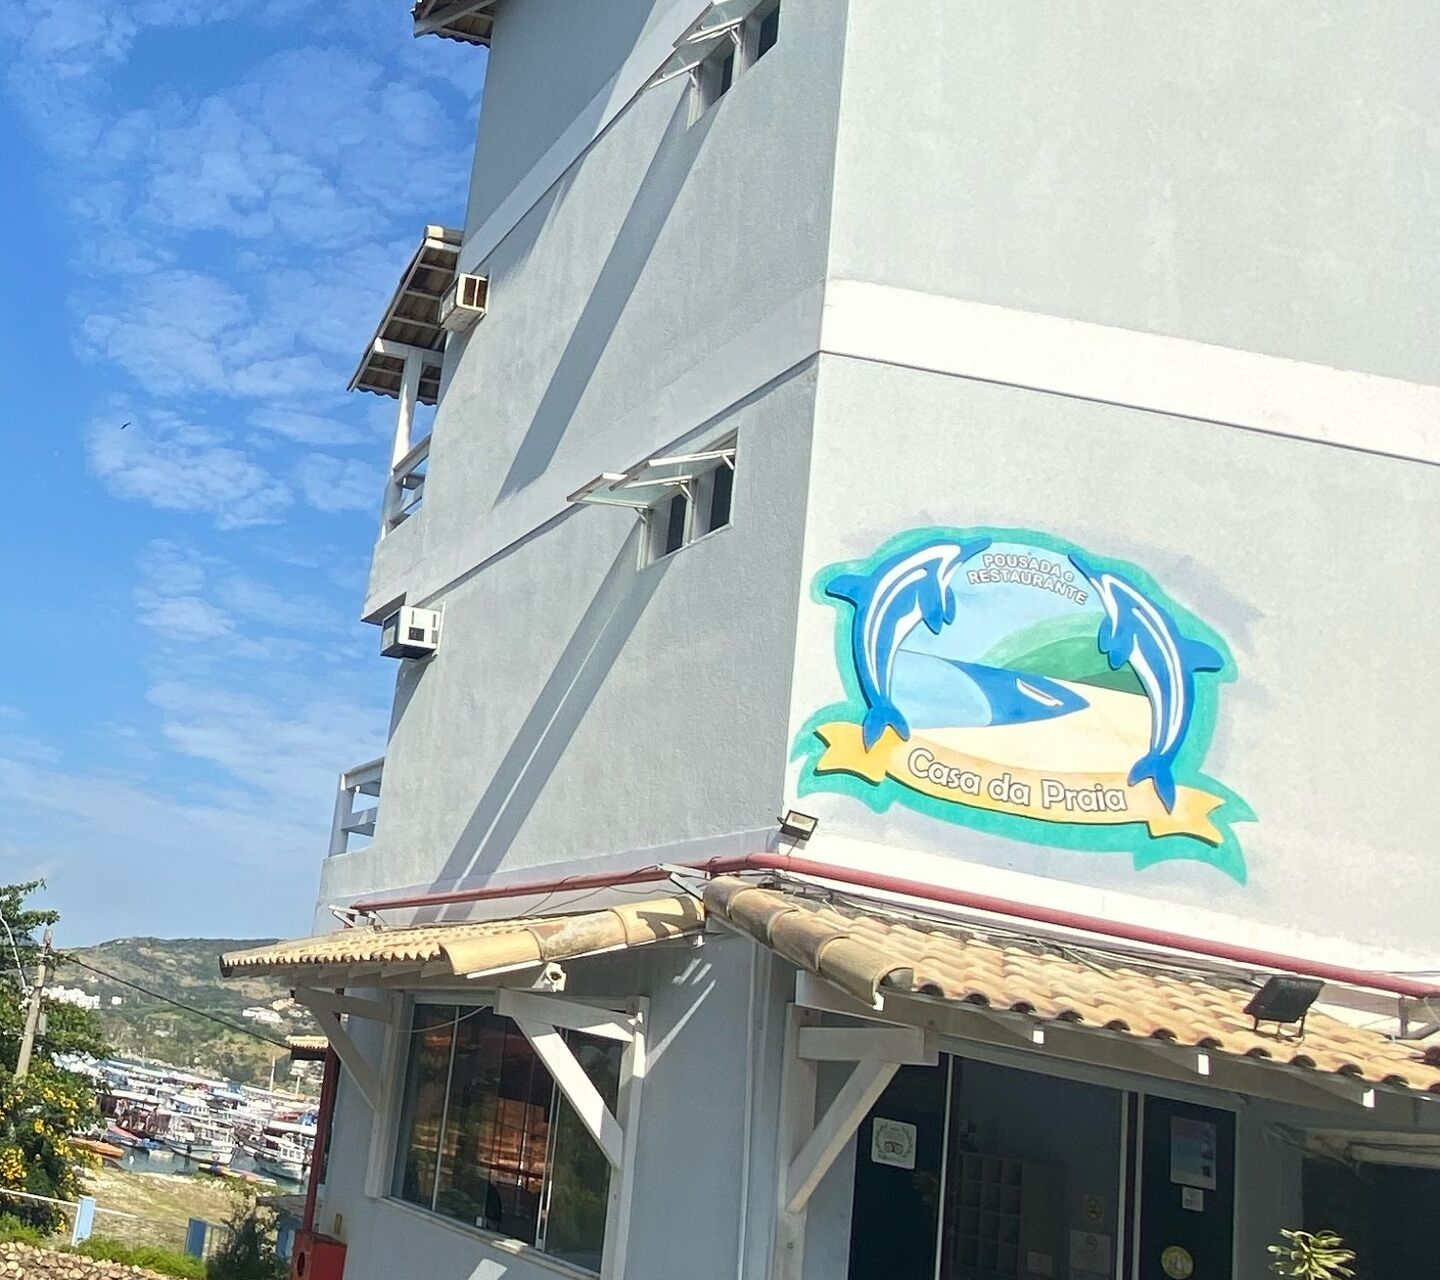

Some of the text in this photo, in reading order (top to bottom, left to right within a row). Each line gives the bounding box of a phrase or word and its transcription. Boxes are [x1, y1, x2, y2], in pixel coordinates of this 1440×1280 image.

[983, 553, 1061, 577] POUSADA
[967, 567, 1088, 605] RESTAURANTE
[908, 747, 1128, 812] Casa da Praia
